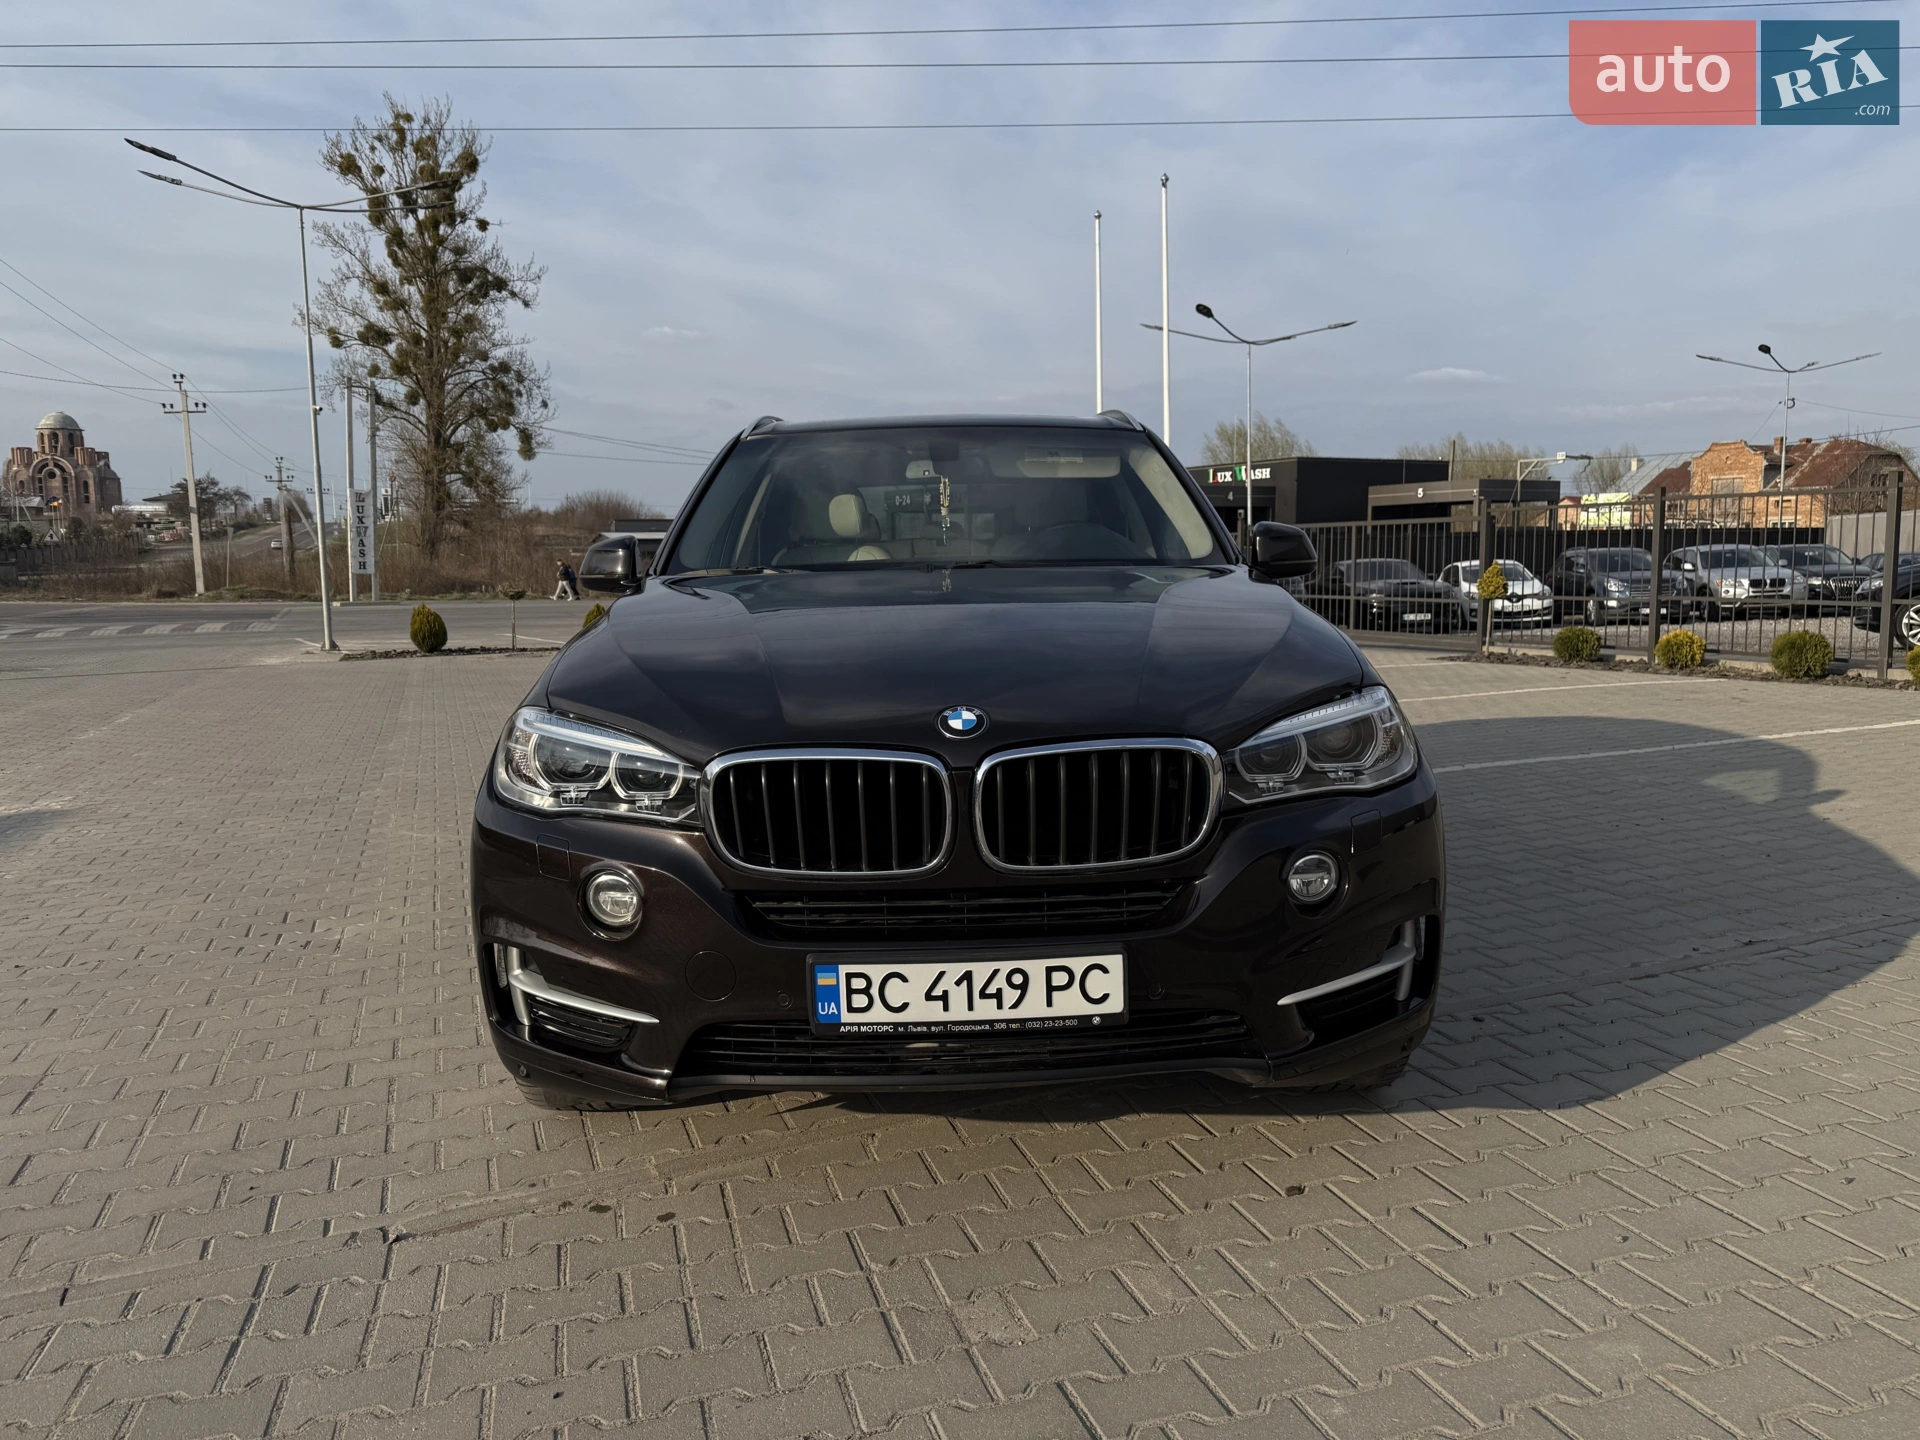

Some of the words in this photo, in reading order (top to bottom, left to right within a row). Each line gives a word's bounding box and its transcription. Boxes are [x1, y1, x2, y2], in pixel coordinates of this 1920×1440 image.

[1208, 468, 1233, 484] LUX
[845, 971, 910, 1014] BC
[924, 967, 1029, 1012] 4149
[1045, 963, 1110, 1008] PC
[818, 1003, 838, 1015] UA
[840, 1025, 859, 1033] АРІЯ
[860, 1025, 894, 1033] МОТОРС
[1025, 1020, 1043, 1029] (032)
[1044, 1019, 1078, 1027] 23-23-500
